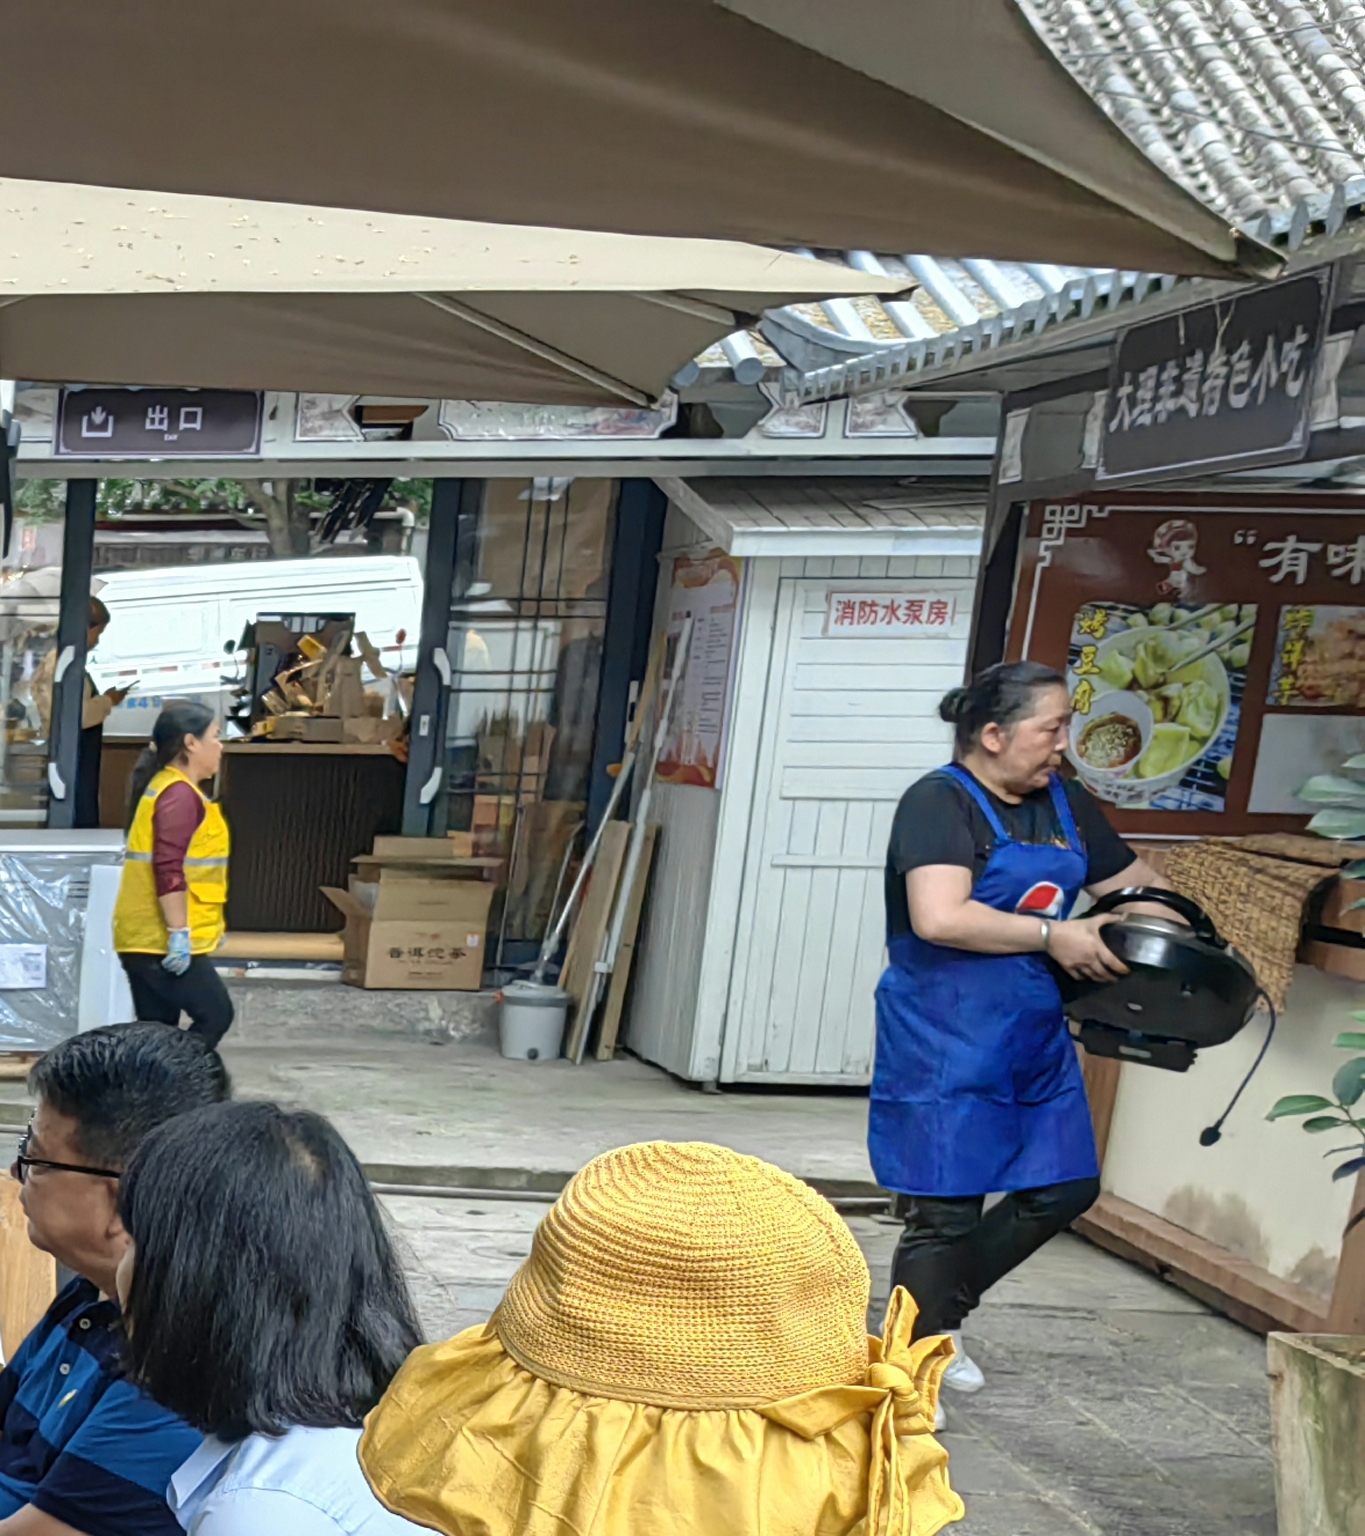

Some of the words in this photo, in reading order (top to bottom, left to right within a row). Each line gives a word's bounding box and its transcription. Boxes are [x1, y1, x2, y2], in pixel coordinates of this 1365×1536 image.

[144, 404, 204, 431] 出口
[834, 598, 950, 627] 消防水泵房
